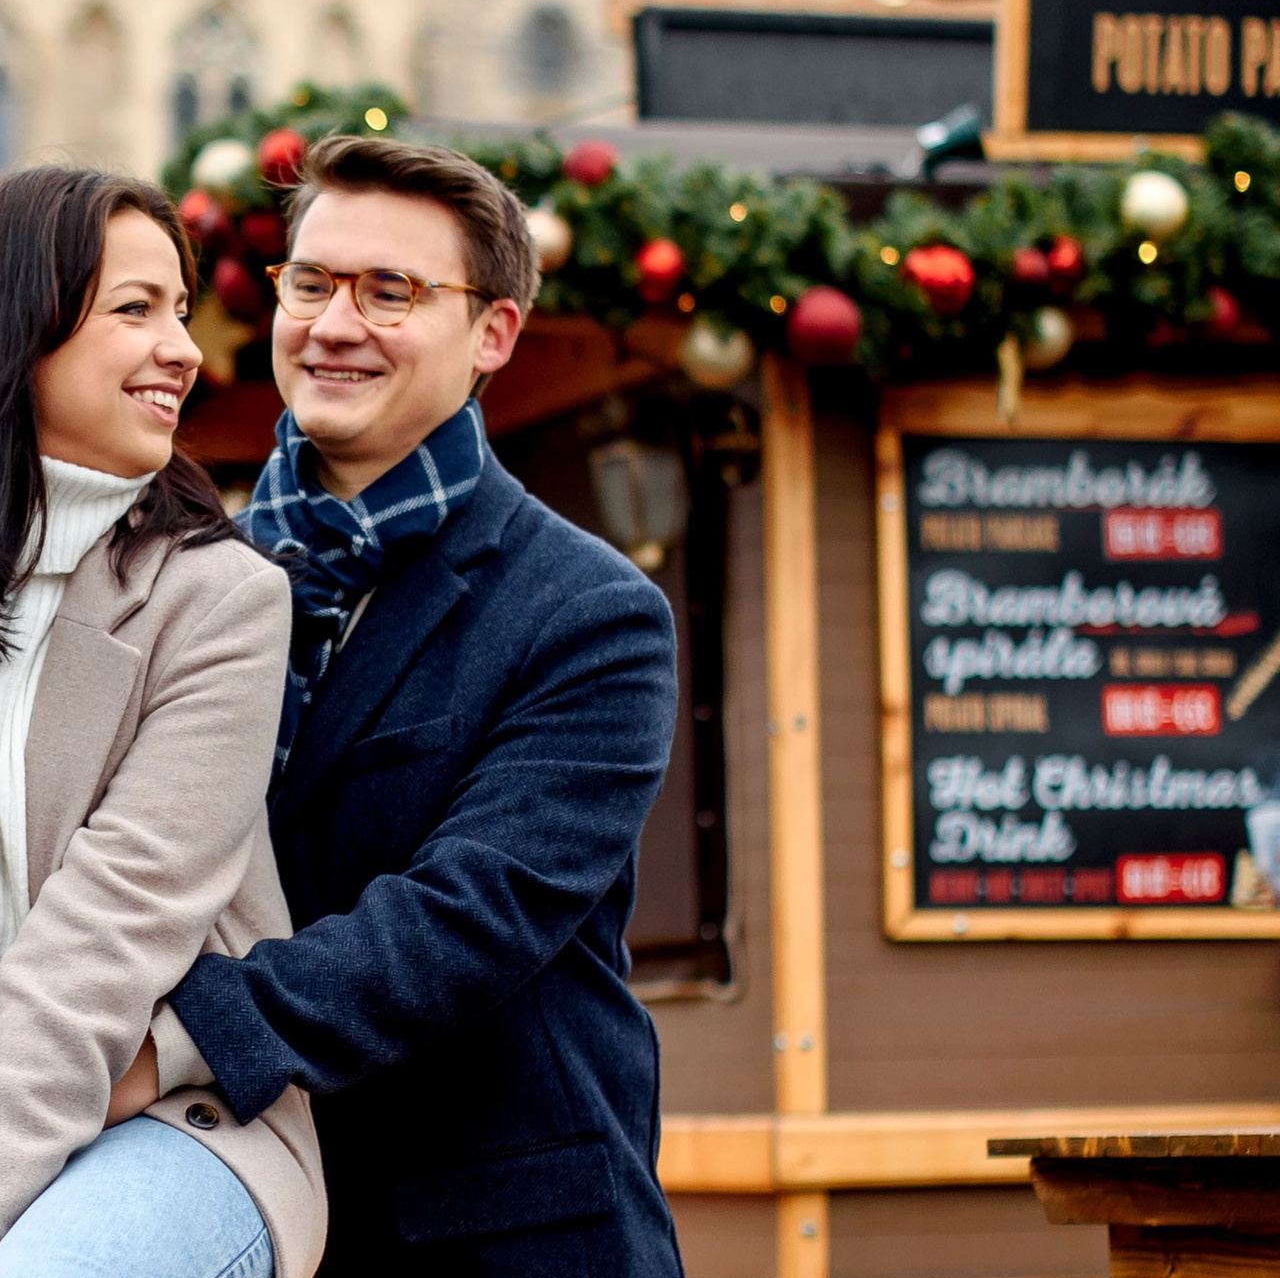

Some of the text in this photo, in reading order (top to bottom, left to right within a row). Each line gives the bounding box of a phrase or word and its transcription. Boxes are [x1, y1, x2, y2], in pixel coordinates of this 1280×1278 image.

[1091, 12, 1231, 96] POTATO
[918, 449, 1217, 508] Bramborák
[921, 570, 1228, 627] Bramborová
[928, 754, 1263, 811] Hot Christmas
[929, 809, 1077, 863] Drink
